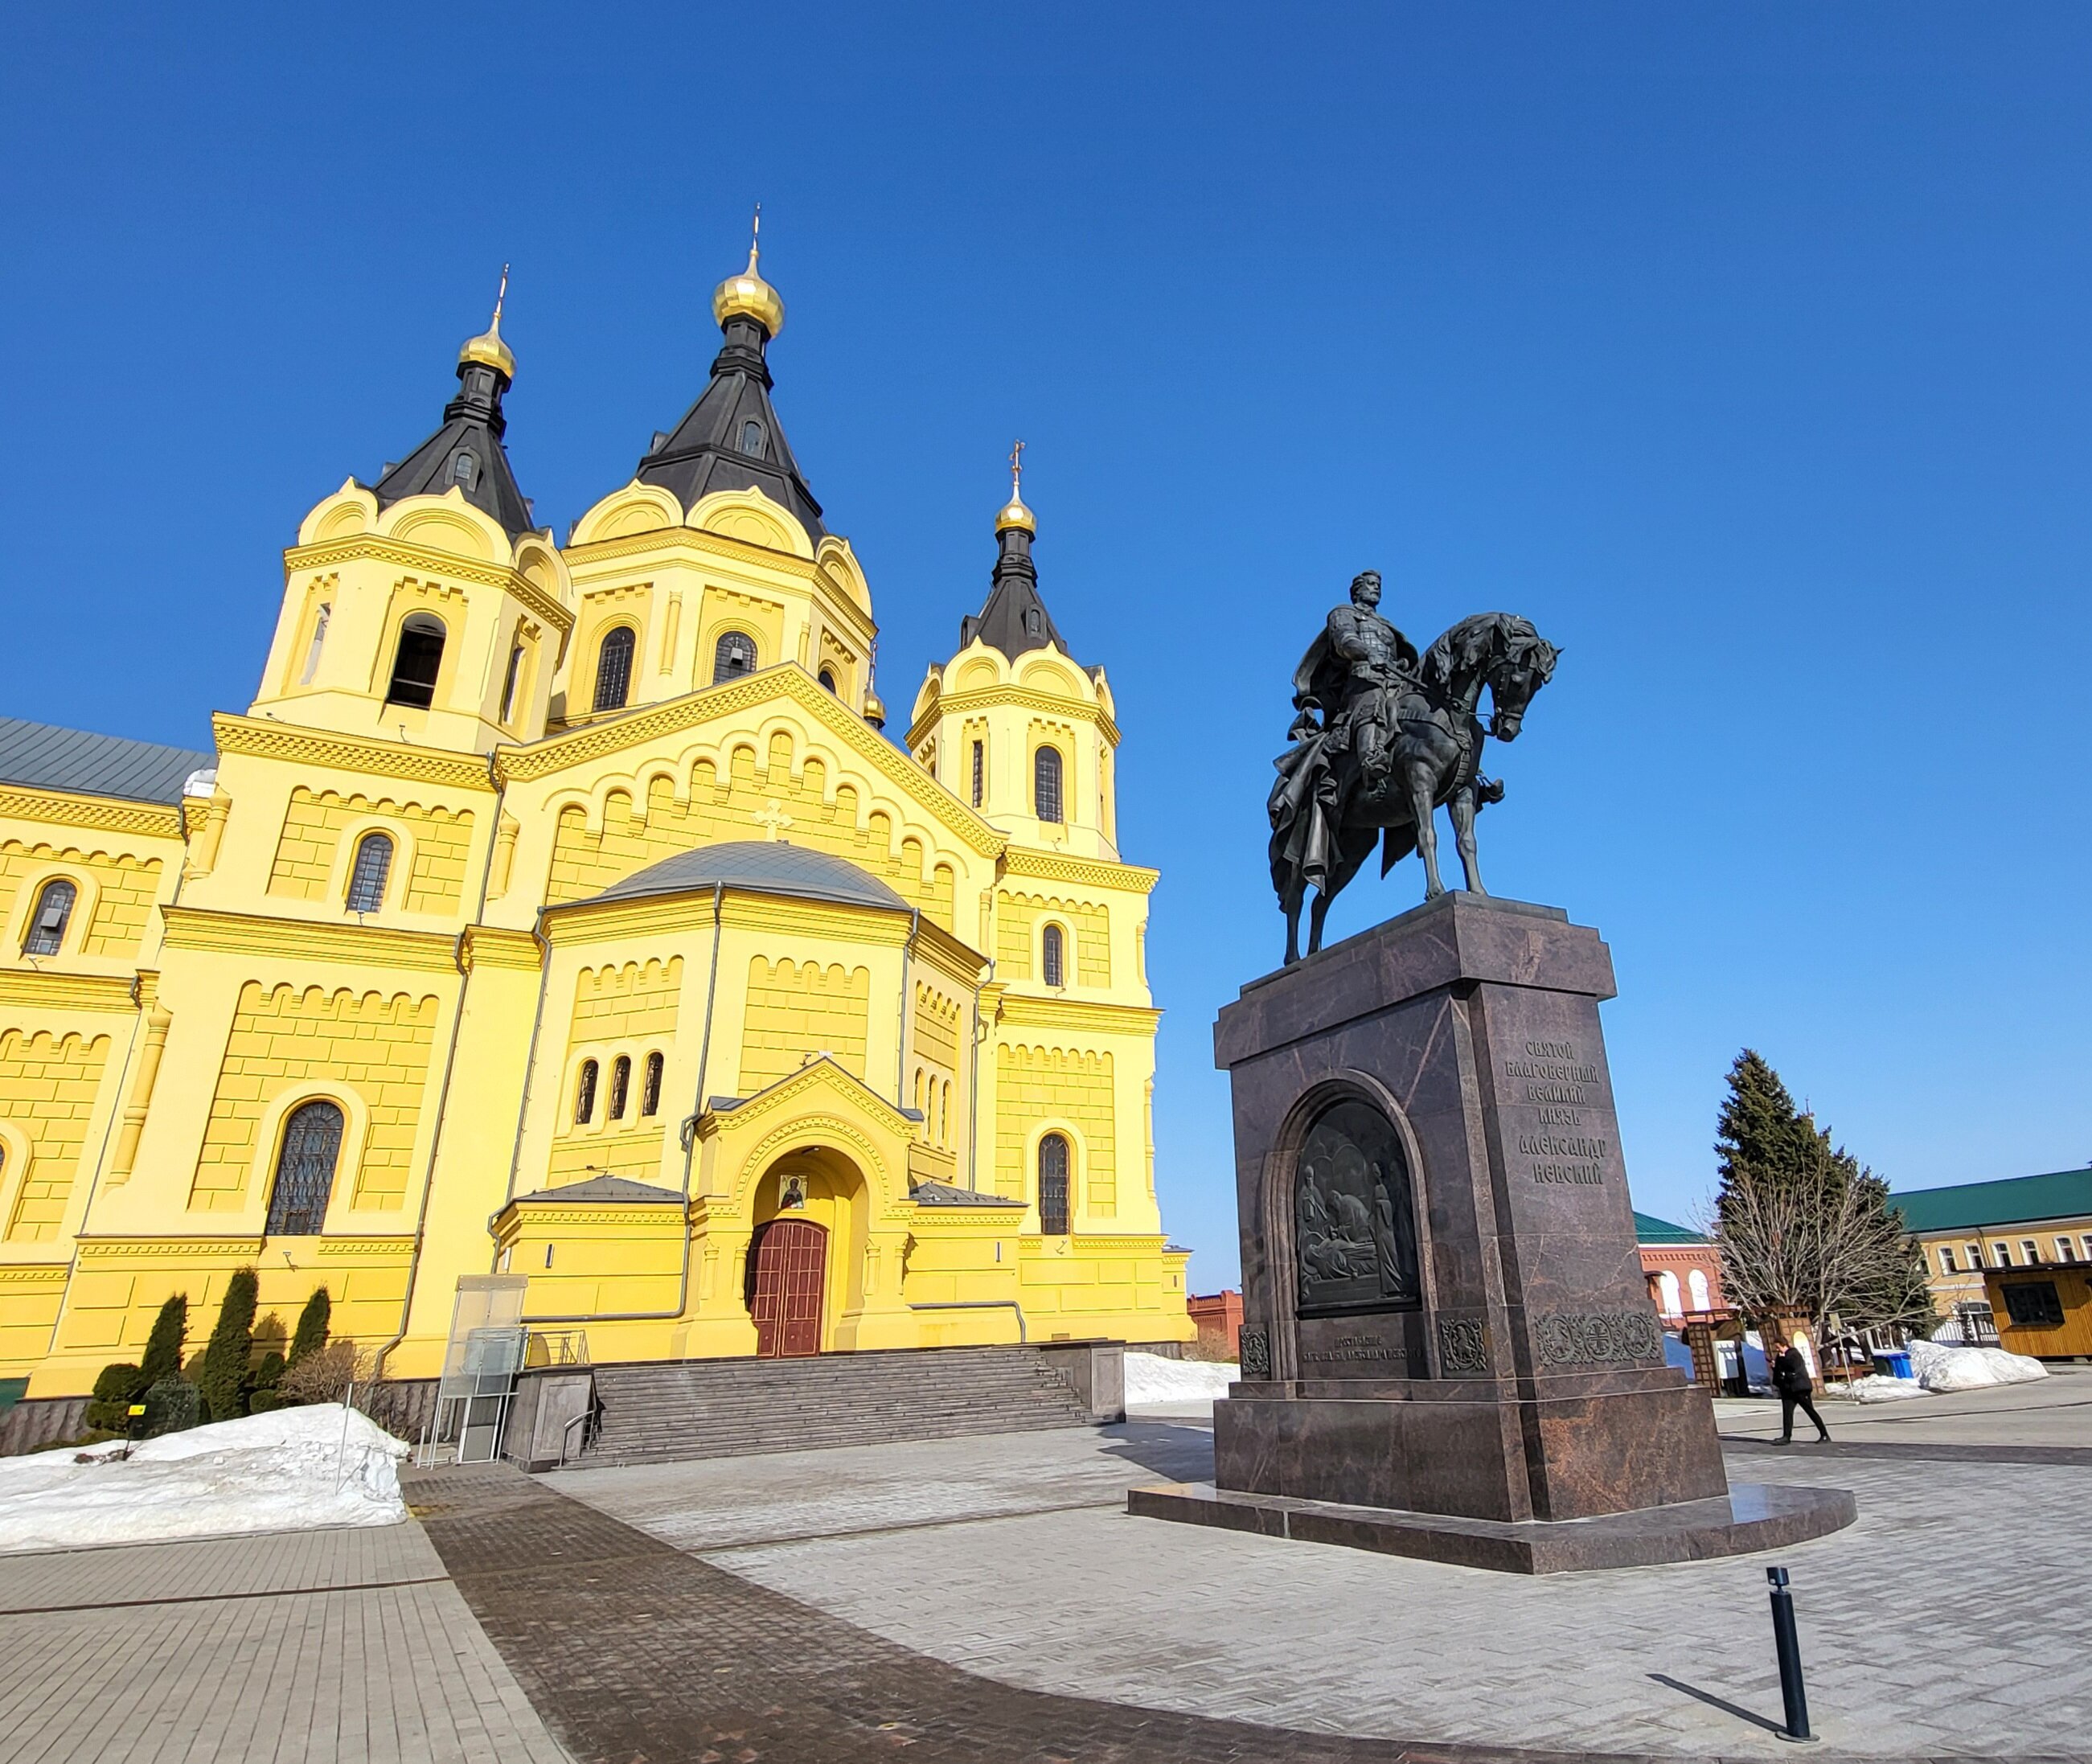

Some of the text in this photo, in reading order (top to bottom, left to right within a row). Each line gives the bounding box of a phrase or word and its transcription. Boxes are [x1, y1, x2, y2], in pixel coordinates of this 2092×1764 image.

[1539, 1107, 1581, 1126] КНЯЗЬ
[1519, 1135, 1606, 1159] АЛЕКСАНДР
[1533, 1163, 1603, 1184] НЕВСКИЙ
